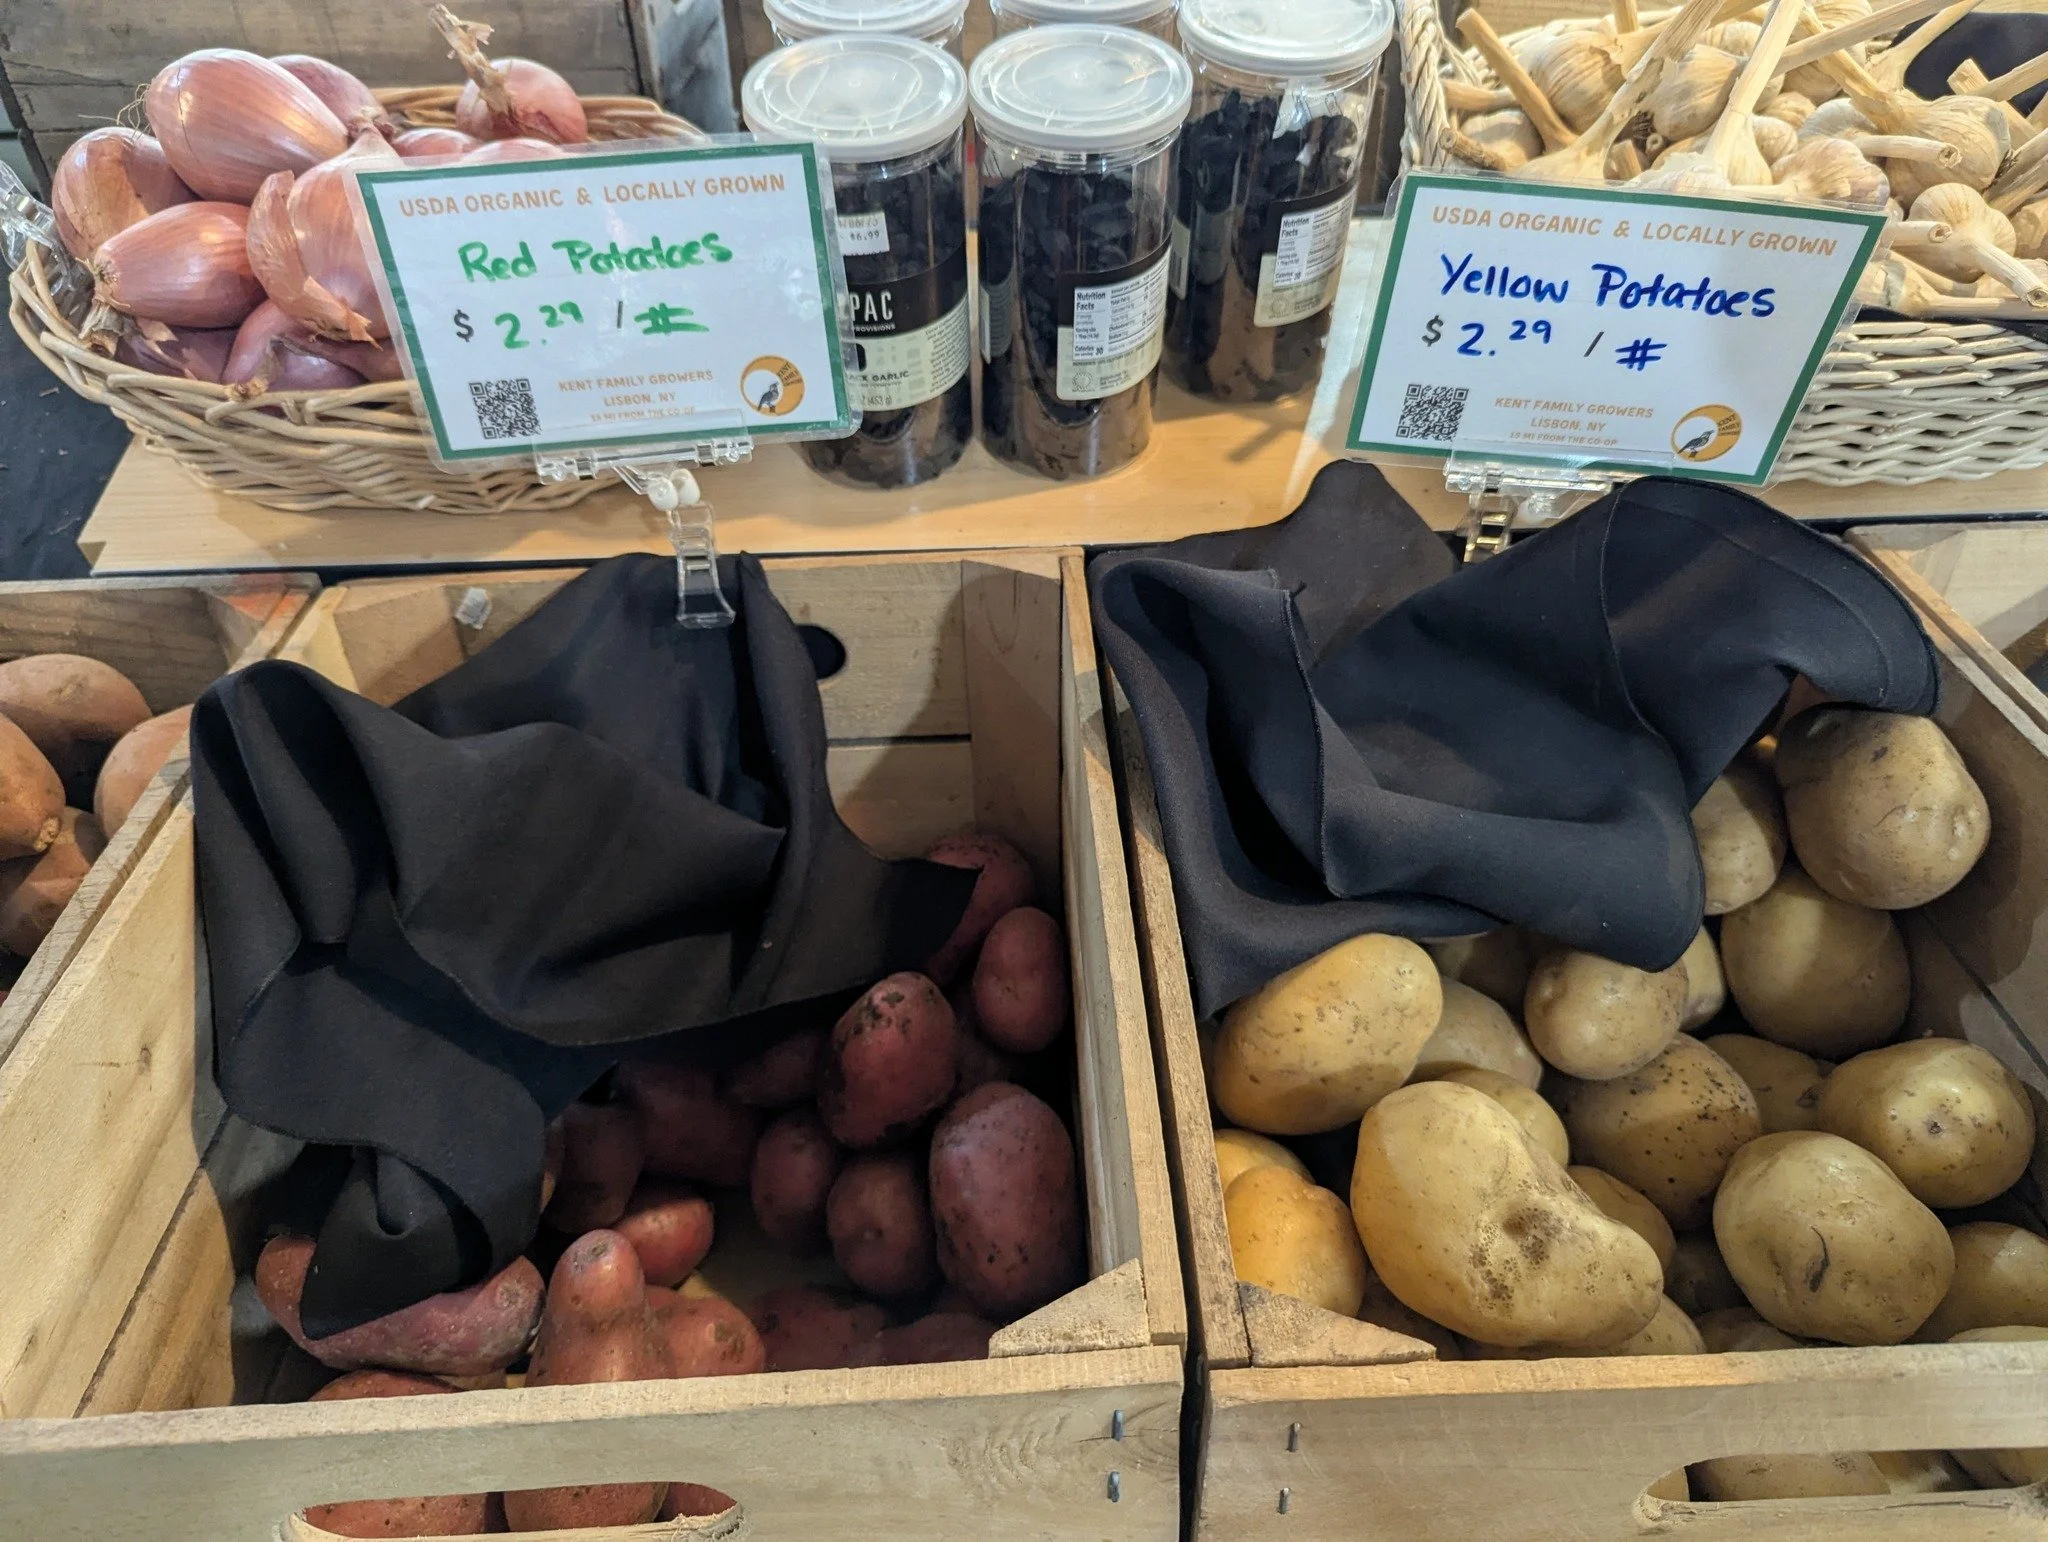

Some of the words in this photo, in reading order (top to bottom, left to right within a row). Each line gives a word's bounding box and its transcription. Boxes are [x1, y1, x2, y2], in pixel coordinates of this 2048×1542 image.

[400, 197, 459, 217] USDA
[465, 189, 564, 213] ORGANIC
[576, 187, 592, 205] &
[604, 180, 697, 202] LOCALLY
[703, 174, 786, 195] GROWN
[1283, 217, 1310, 229] Nutrition
[1433, 206, 1494, 228] USDA
[1499, 211, 1602, 236] ORGANIC
[1614, 221, 1630, 238] &
[1643, 221, 1745, 246] LOCALLY
[1748, 232, 1838, 256] GROWN
[850, 229, 880, 241] $6.99
[1281, 229, 1299, 238] Facts
[458, 240, 538, 283] Red
[552, 232, 733, 276] Potatoes
[1440, 253, 1568, 304] Yellow
[1591, 263, 1776, 317] Potatoes
[1076, 291, 1106, 301] Nutrition
[846, 291, 894, 322] PAC
[1076, 302, 1095, 311] Facts
[454, 310, 474, 343] $
[634, 302, 710, 336] #
[1421, 314, 1444, 347] $
[1615, 337, 1668, 371] #
[558, 379, 593, 392] KENT
[597, 375, 645, 389] FAMILY
[649, 370, 714, 385] GROWERS
[872, 370, 910, 382] GARLIC
[659, 392, 676, 403] NY
[618, 410, 645, 420] FROM
[1494, 397, 1531, 409] KENT
[1533, 400, 1584, 413] FAMILY
[1586, 404, 1654, 418] GROWERS
[1587, 421, 1606, 432] NY
[1510, 431, 1521, 439] 15
[1522, 432, 1534, 440] MI
[1537, 433, 1565, 442] FROM
[1567, 435, 1585, 444] THE
[1587, 438, 1618, 447] CO-OP
